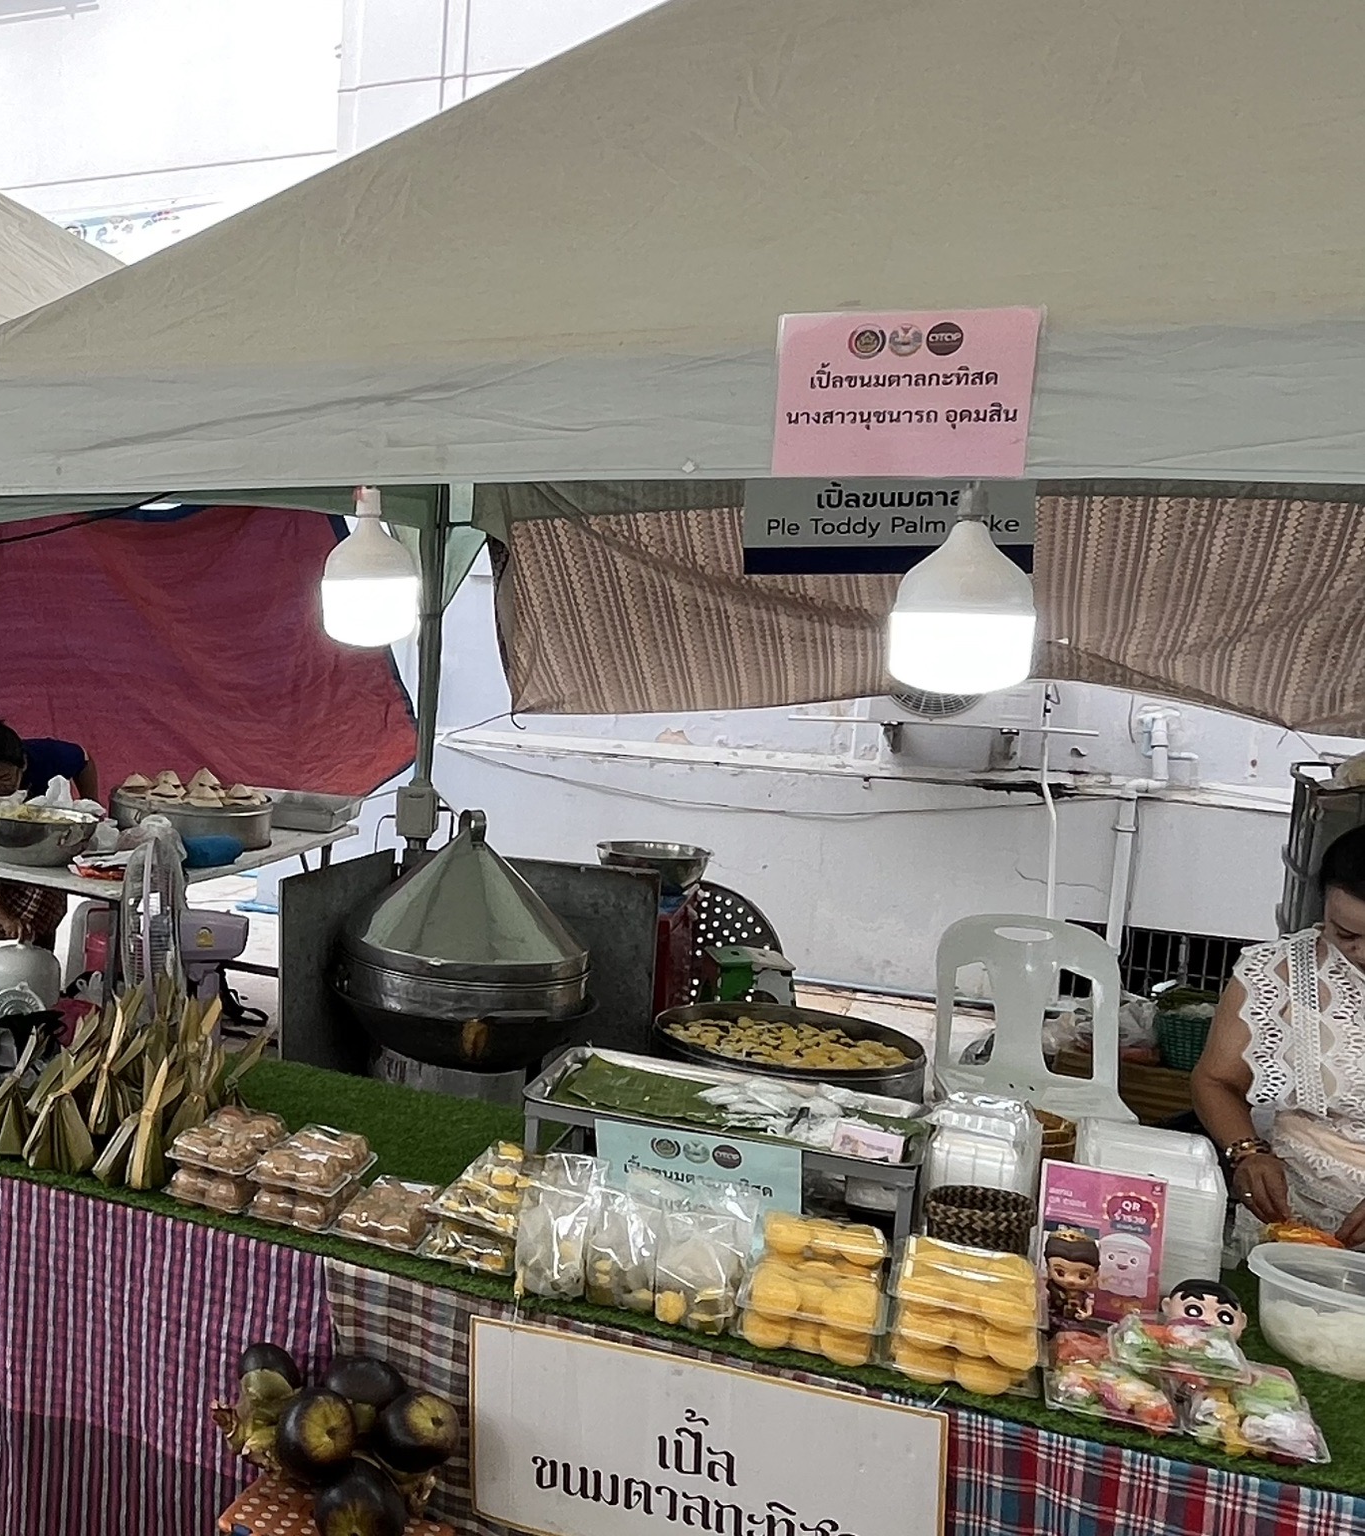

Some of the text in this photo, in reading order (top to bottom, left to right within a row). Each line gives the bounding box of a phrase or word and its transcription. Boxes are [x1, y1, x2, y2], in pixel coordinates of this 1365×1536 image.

[929, 332, 962, 343] OTOP
[810, 363, 999, 389] เปิ้ลขนมตาลกะทิสด
[786, 402, 1018, 430] นางสาวนุชนารถ อุดมสิน
[767, 514, 1020, 539] Ple Toddy Palm ke
[1121, 1200, 1142, 1212] QR
[657, 1408, 738, 1487] เปิ้ล
[531, 1454, 857, 1536] ขนมตาลกะทิ
